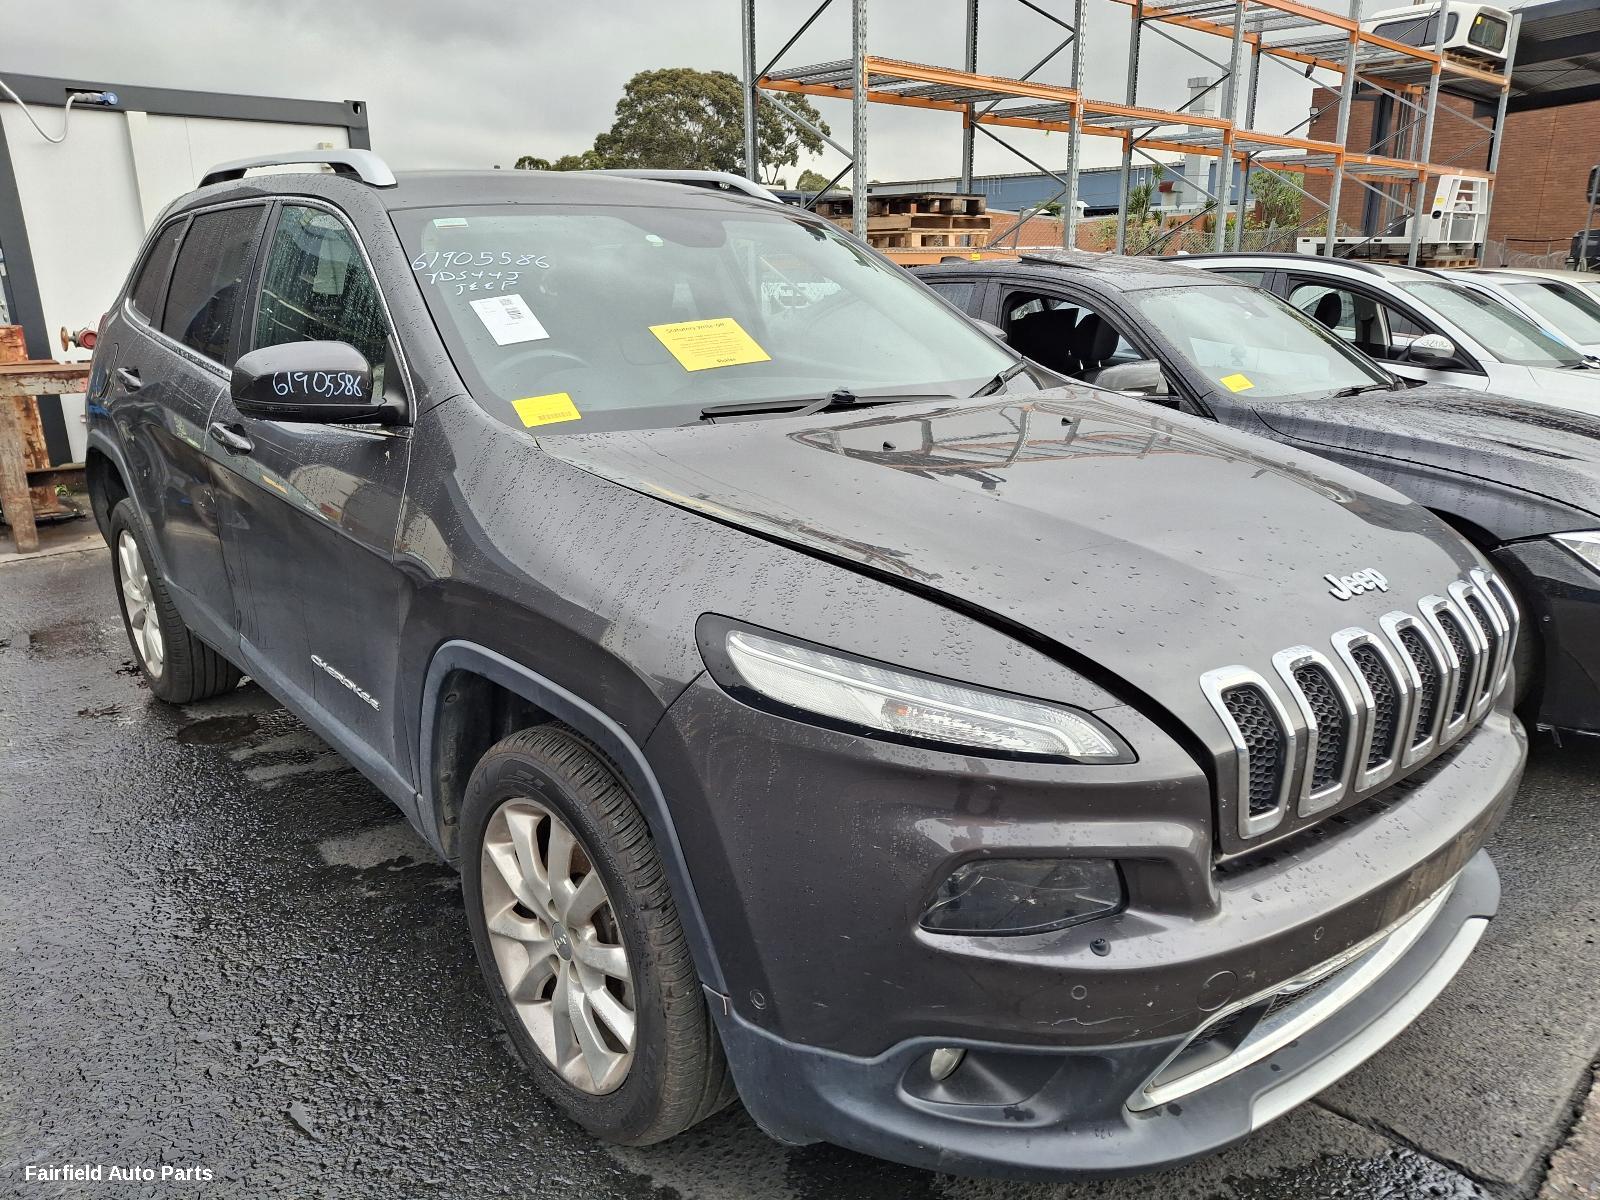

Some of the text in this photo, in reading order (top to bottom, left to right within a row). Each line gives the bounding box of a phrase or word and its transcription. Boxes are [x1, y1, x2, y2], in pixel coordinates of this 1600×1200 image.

[412, 251, 550, 271] 61905586
[272, 371, 362, 398] 61905586
[1323, 567, 1389, 601] Jeep
